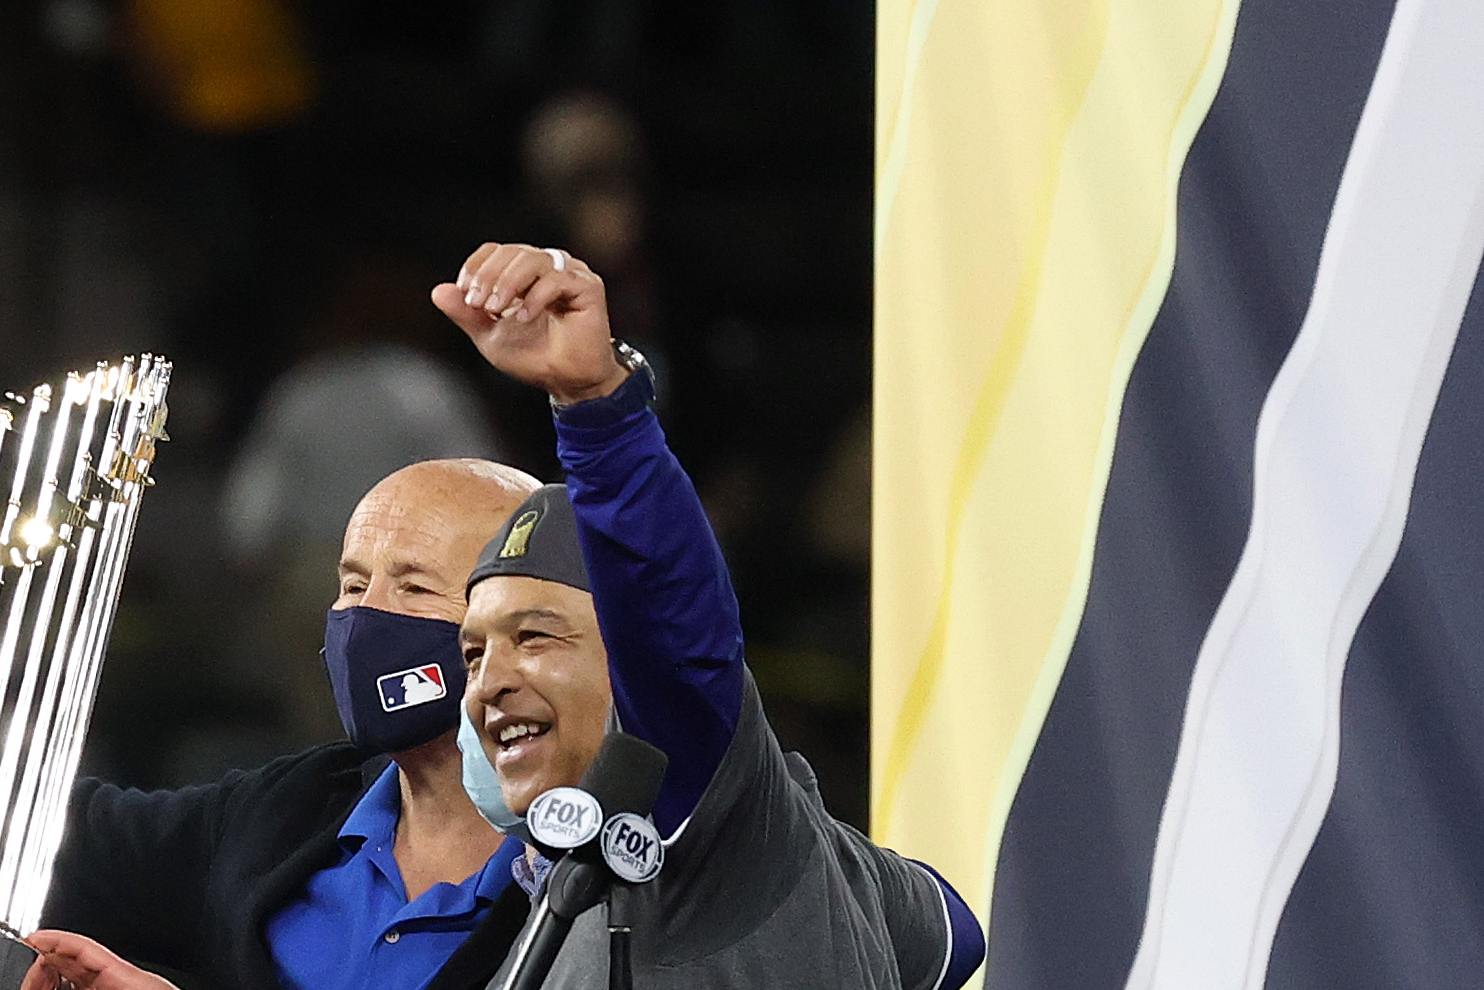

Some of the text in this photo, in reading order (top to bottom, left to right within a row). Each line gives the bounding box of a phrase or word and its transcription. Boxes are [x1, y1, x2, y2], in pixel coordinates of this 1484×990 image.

[544, 797, 590, 828] FOX
[540, 819, 581, 839] SPORTS
[615, 823, 654, 863] FOX
[611, 845, 646, 874] SPORTS
